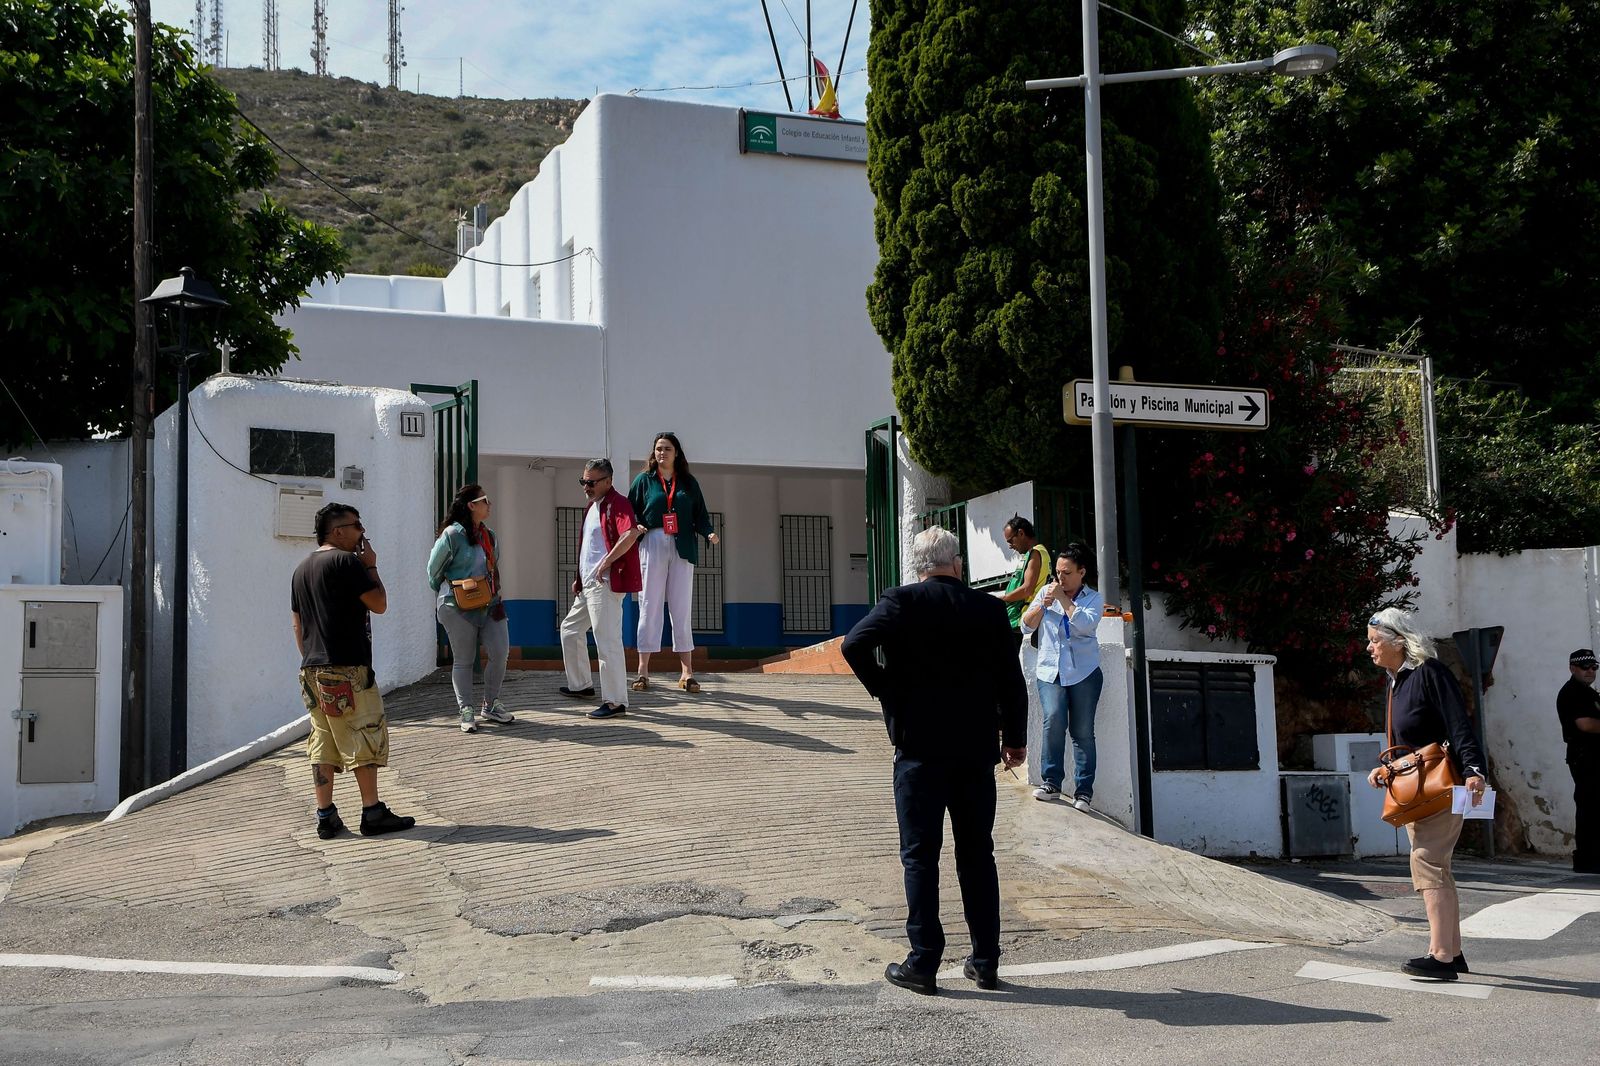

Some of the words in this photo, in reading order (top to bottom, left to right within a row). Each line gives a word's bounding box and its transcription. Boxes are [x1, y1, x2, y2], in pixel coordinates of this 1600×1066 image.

[781, 127, 802, 138] Colegio
[803, 130, 811, 138] de
[811, 130, 840, 141] Educación
[841, 133, 861, 143] Infantil
[1081, 392, 1126, 409] Palón
[1130, 399, 1136, 414] y
[1141, 395, 1179, 412] Piscina
[1184, 398, 1233, 418] Municipal
[407, 416, 418, 433] 11
